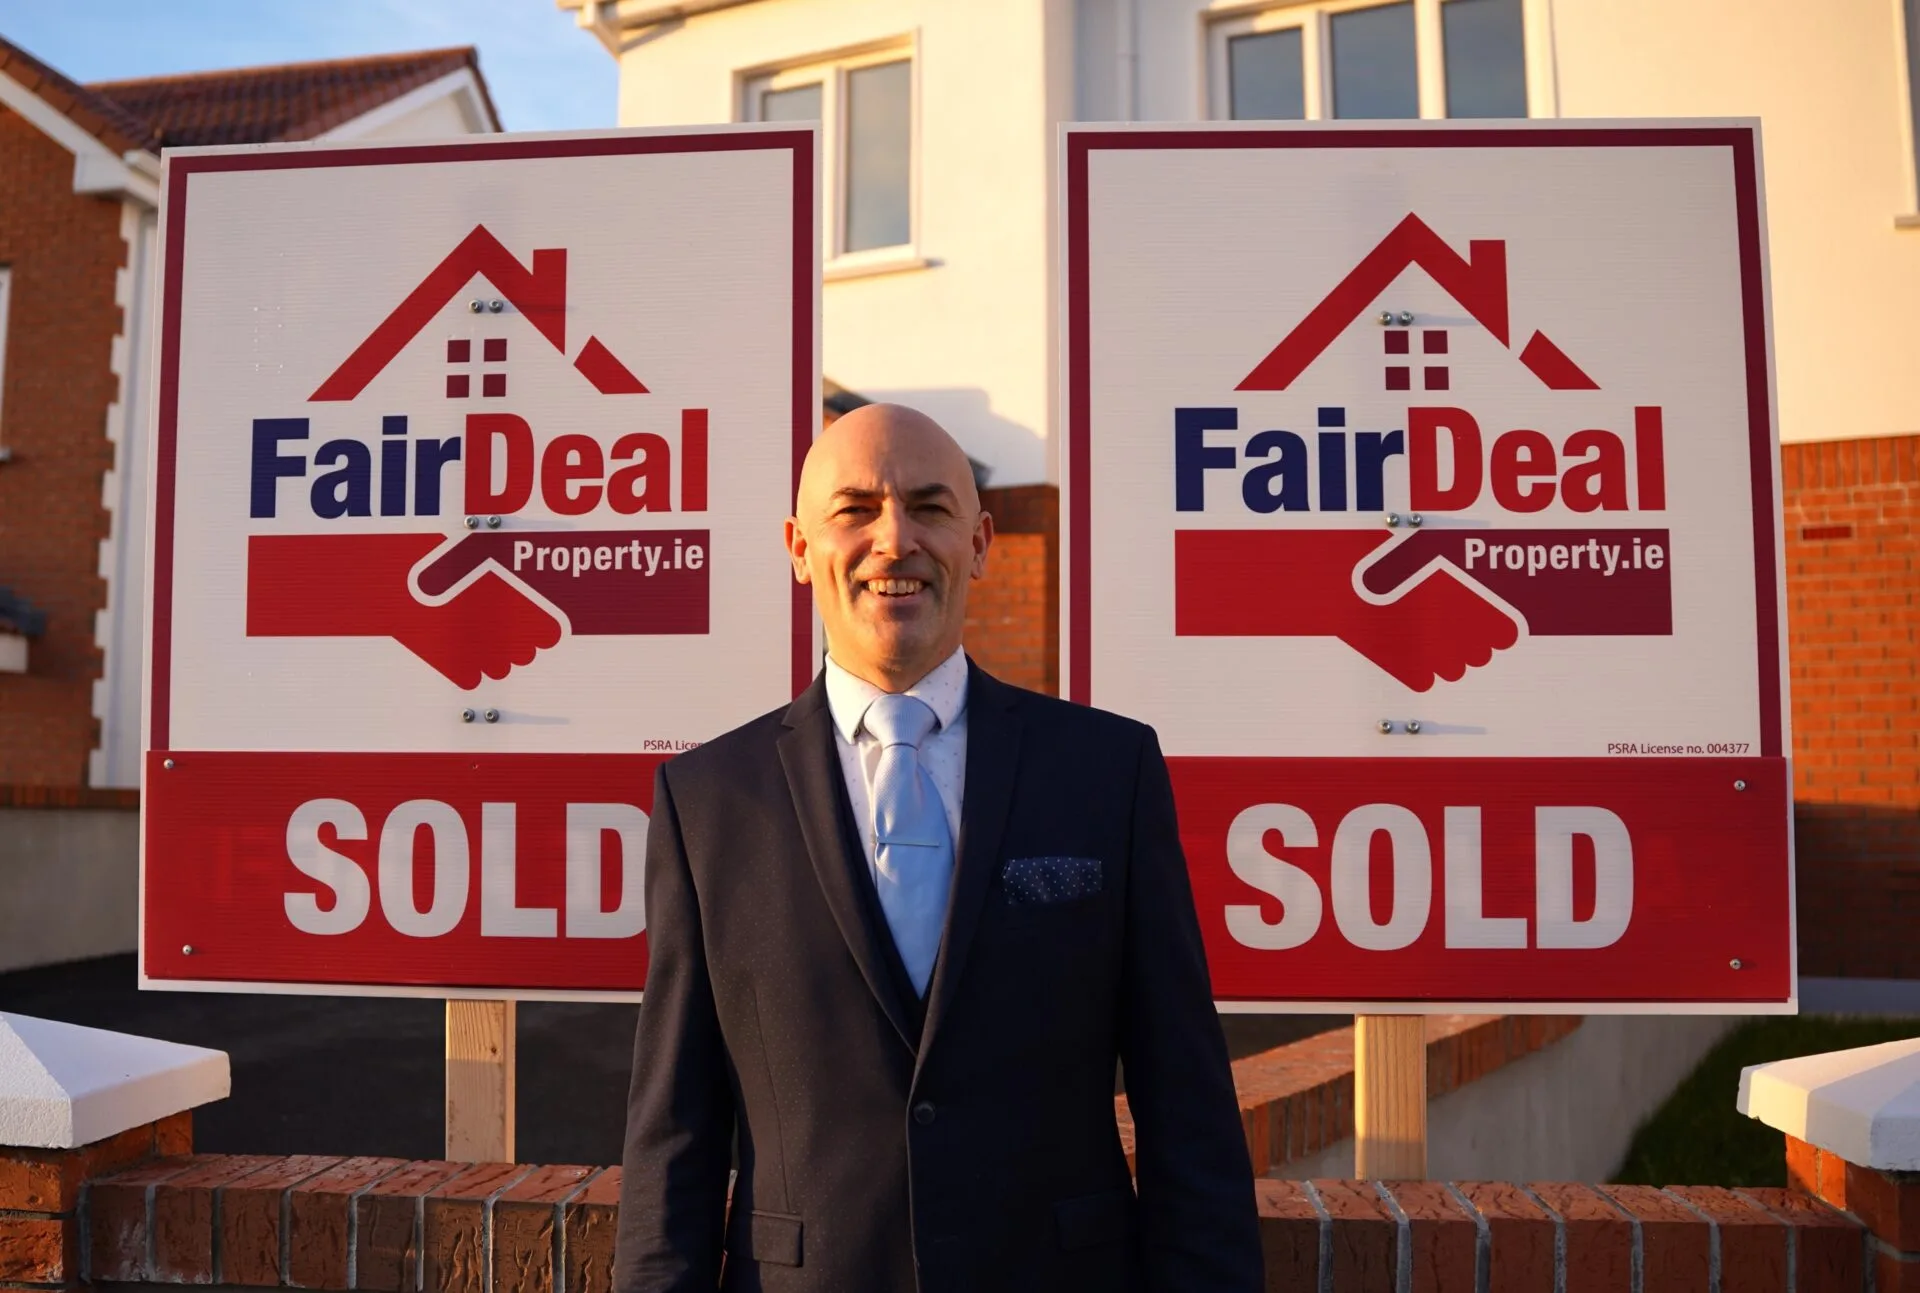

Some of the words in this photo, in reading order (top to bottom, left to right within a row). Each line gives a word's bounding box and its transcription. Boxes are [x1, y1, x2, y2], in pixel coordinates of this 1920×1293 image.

[250, 408, 708, 519] FairDeal
[1175, 406, 1666, 514] FairDeal
[513, 538, 705, 577] Property.ie
[1464, 537, 1665, 576] Property.ie
[643, 740, 672, 750] PSRA
[1607, 743, 1637, 754] PSRA
[1640, 743, 1683, 754] License
[1687, 745, 1704, 754] no.
[1706, 743, 1750, 754] 004377
[284, 798, 651, 938] SOLD
[1224, 803, 1634, 951] SOLD
